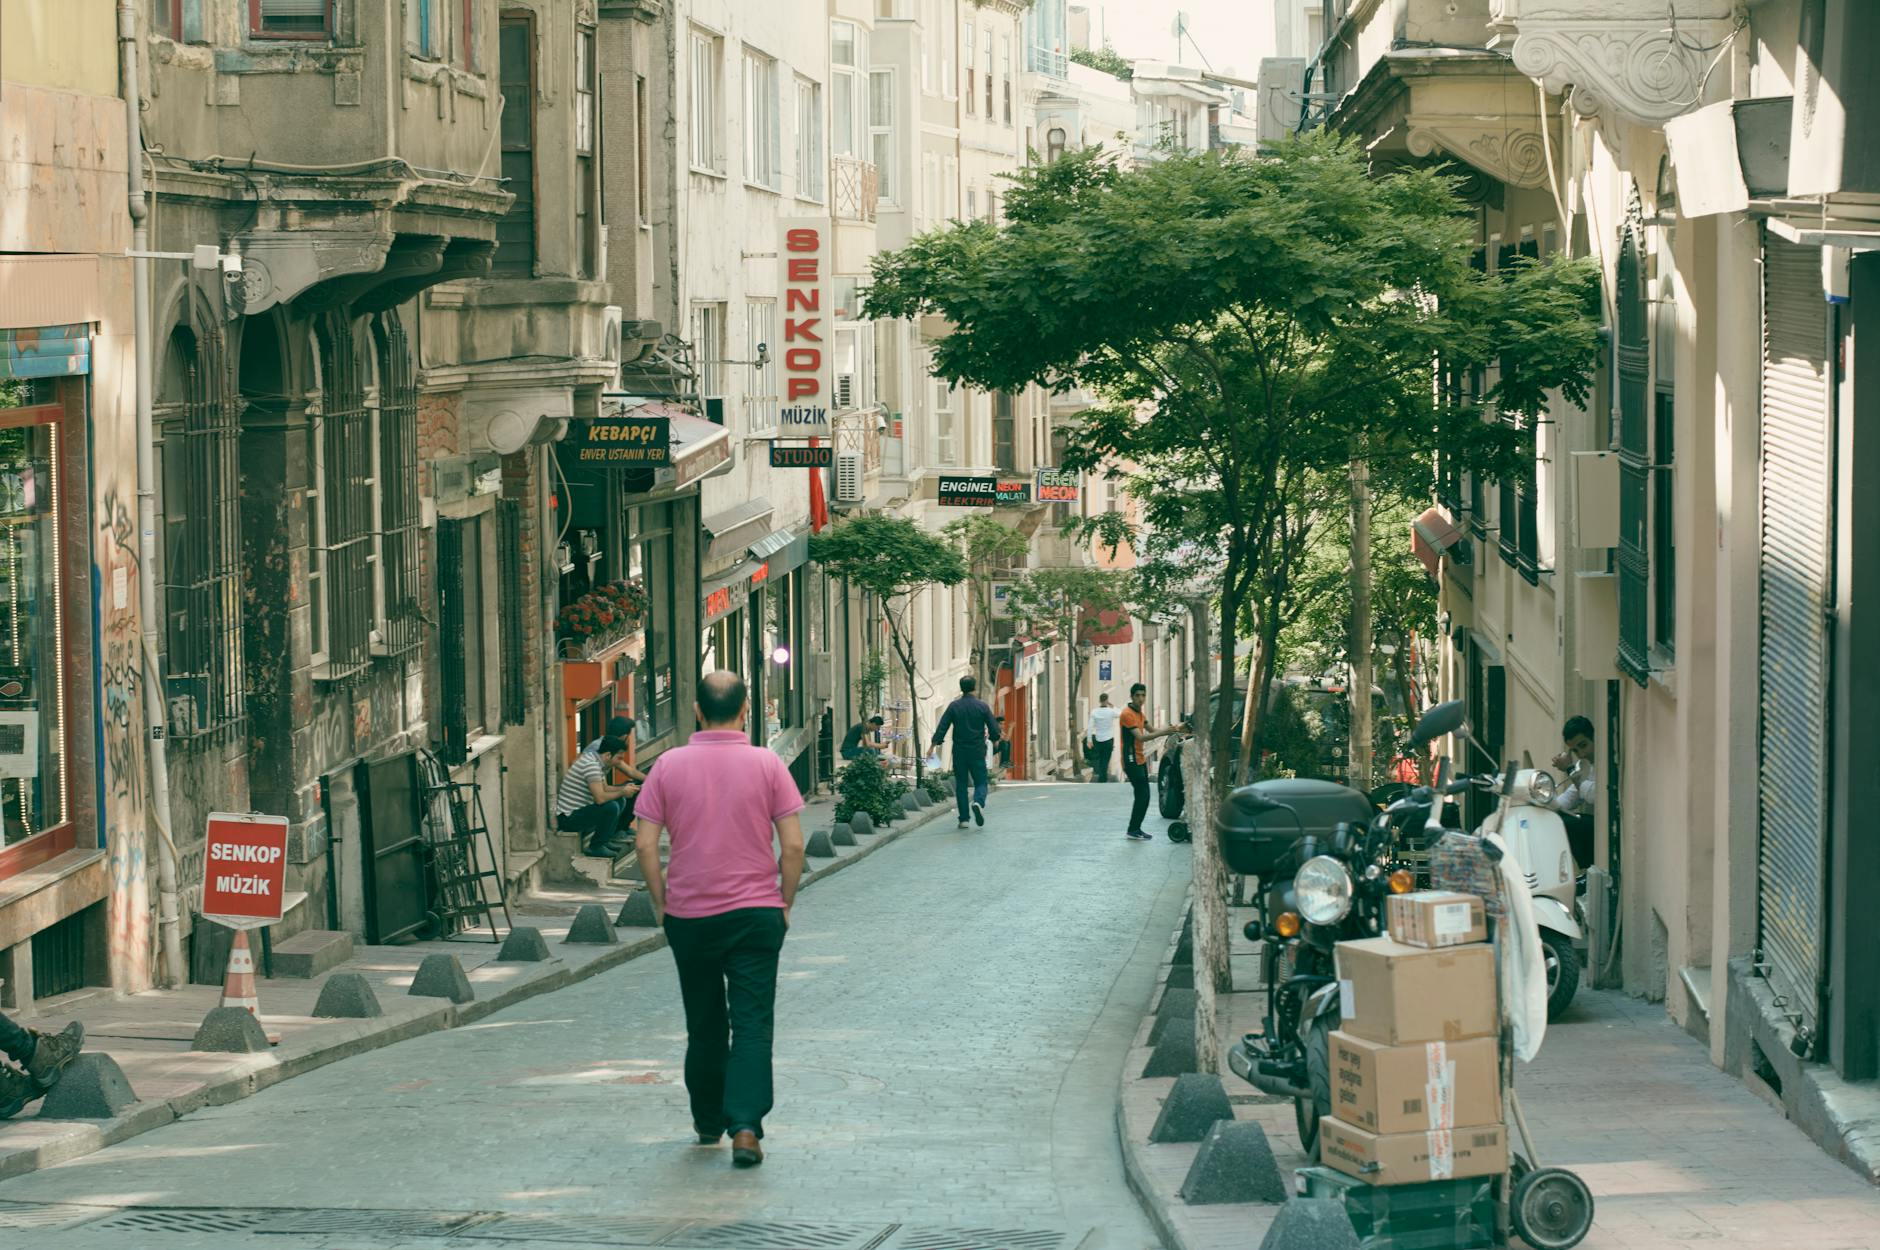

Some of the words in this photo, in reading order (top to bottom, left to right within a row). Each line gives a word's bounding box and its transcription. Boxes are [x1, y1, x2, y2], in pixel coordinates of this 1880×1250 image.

[785, 229, 823, 401] SENKOP
[781, 405, 827, 425] MÜZİK
[588, 425, 657, 444] KEBAPÇI
[580, 448, 606, 460] ENVER
[608, 448, 644, 460] USTANIN
[646, 447, 666, 460] YERİ
[773, 449, 830, 465] STUDIO
[940, 478, 996, 493] ENGİNEL
[996, 482, 1022, 492] NEON
[1041, 472, 1079, 486] EREN
[1039, 486, 1078, 500] NEON
[210, 843, 281, 864] SENKOP
[216, 873, 271, 896] MÜZİK
